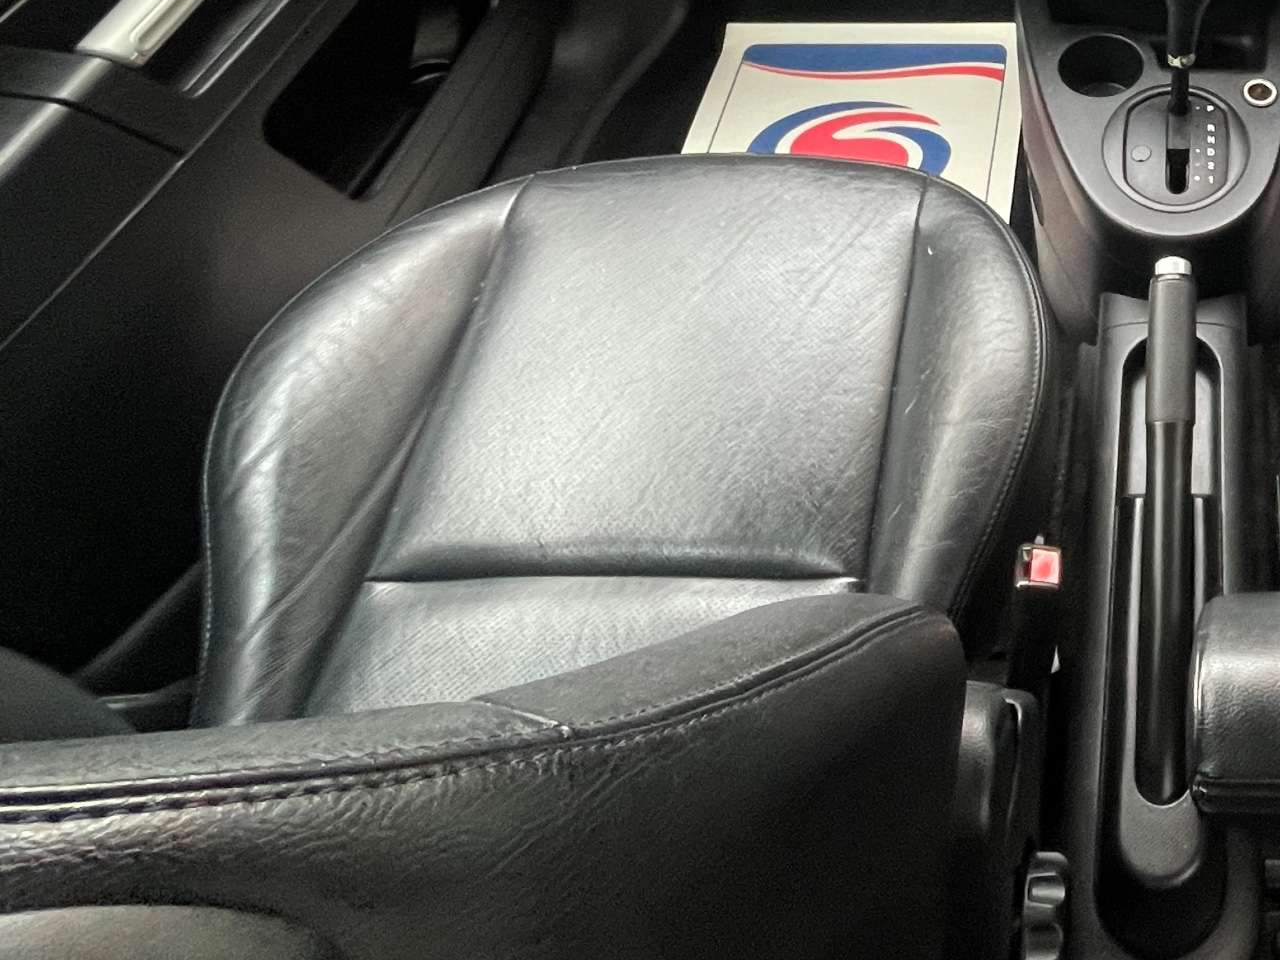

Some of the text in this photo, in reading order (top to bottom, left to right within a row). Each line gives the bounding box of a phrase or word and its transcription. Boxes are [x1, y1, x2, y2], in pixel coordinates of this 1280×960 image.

[1207, 124, 1215, 132] R
[1207, 135, 1215, 144] N
[1207, 147, 1215, 156] D
[1207, 161, 1215, 170] 2
